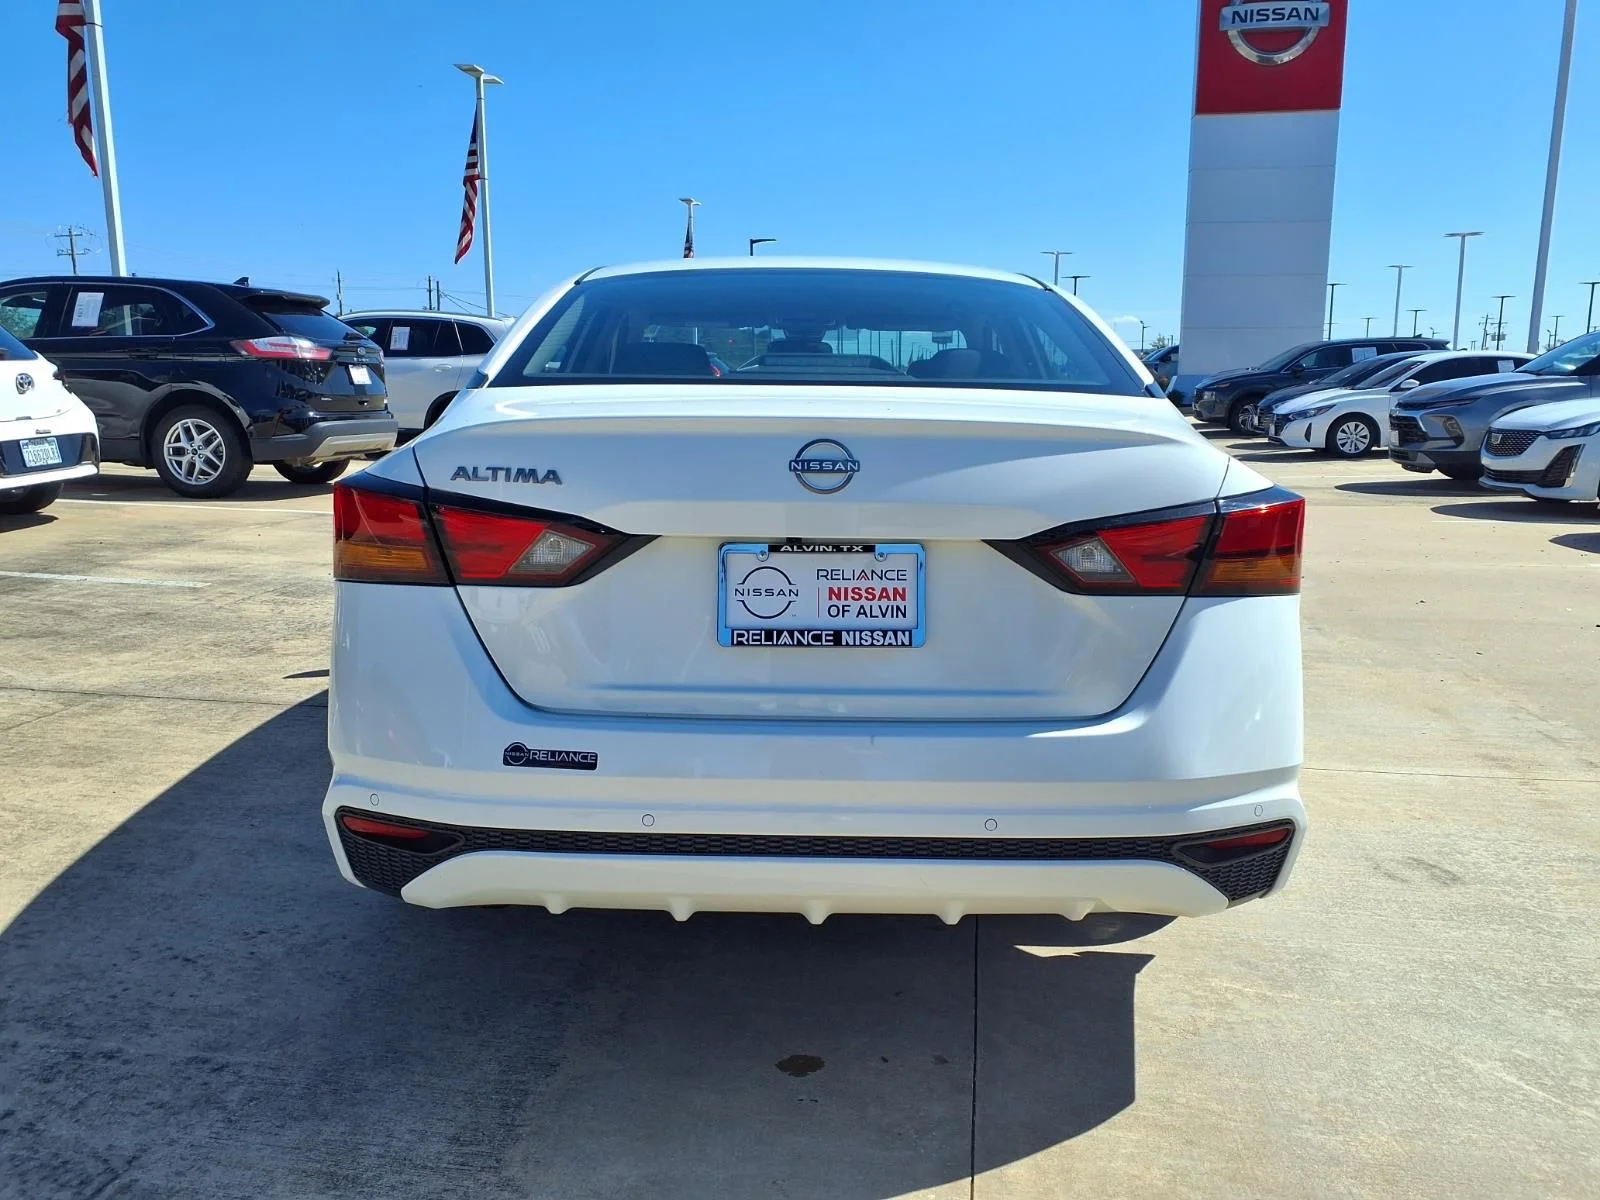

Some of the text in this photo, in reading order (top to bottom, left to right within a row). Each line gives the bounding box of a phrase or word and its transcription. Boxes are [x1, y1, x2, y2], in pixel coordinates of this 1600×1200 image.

[1231, 7, 1320, 24] NISSAN
[791, 461, 859, 471] NISSAN
[450, 466, 563, 485] ALTIMA
[816, 569, 907, 581] RELIANCE
[734, 588, 799, 597] NISSAN
[828, 586, 907, 602] NISSAN
[827, 604, 907, 618] OF ALVIN
[733, 630, 910, 646] RELIANCE NISSAN
[529, 750, 597, 763] RELIANCE
